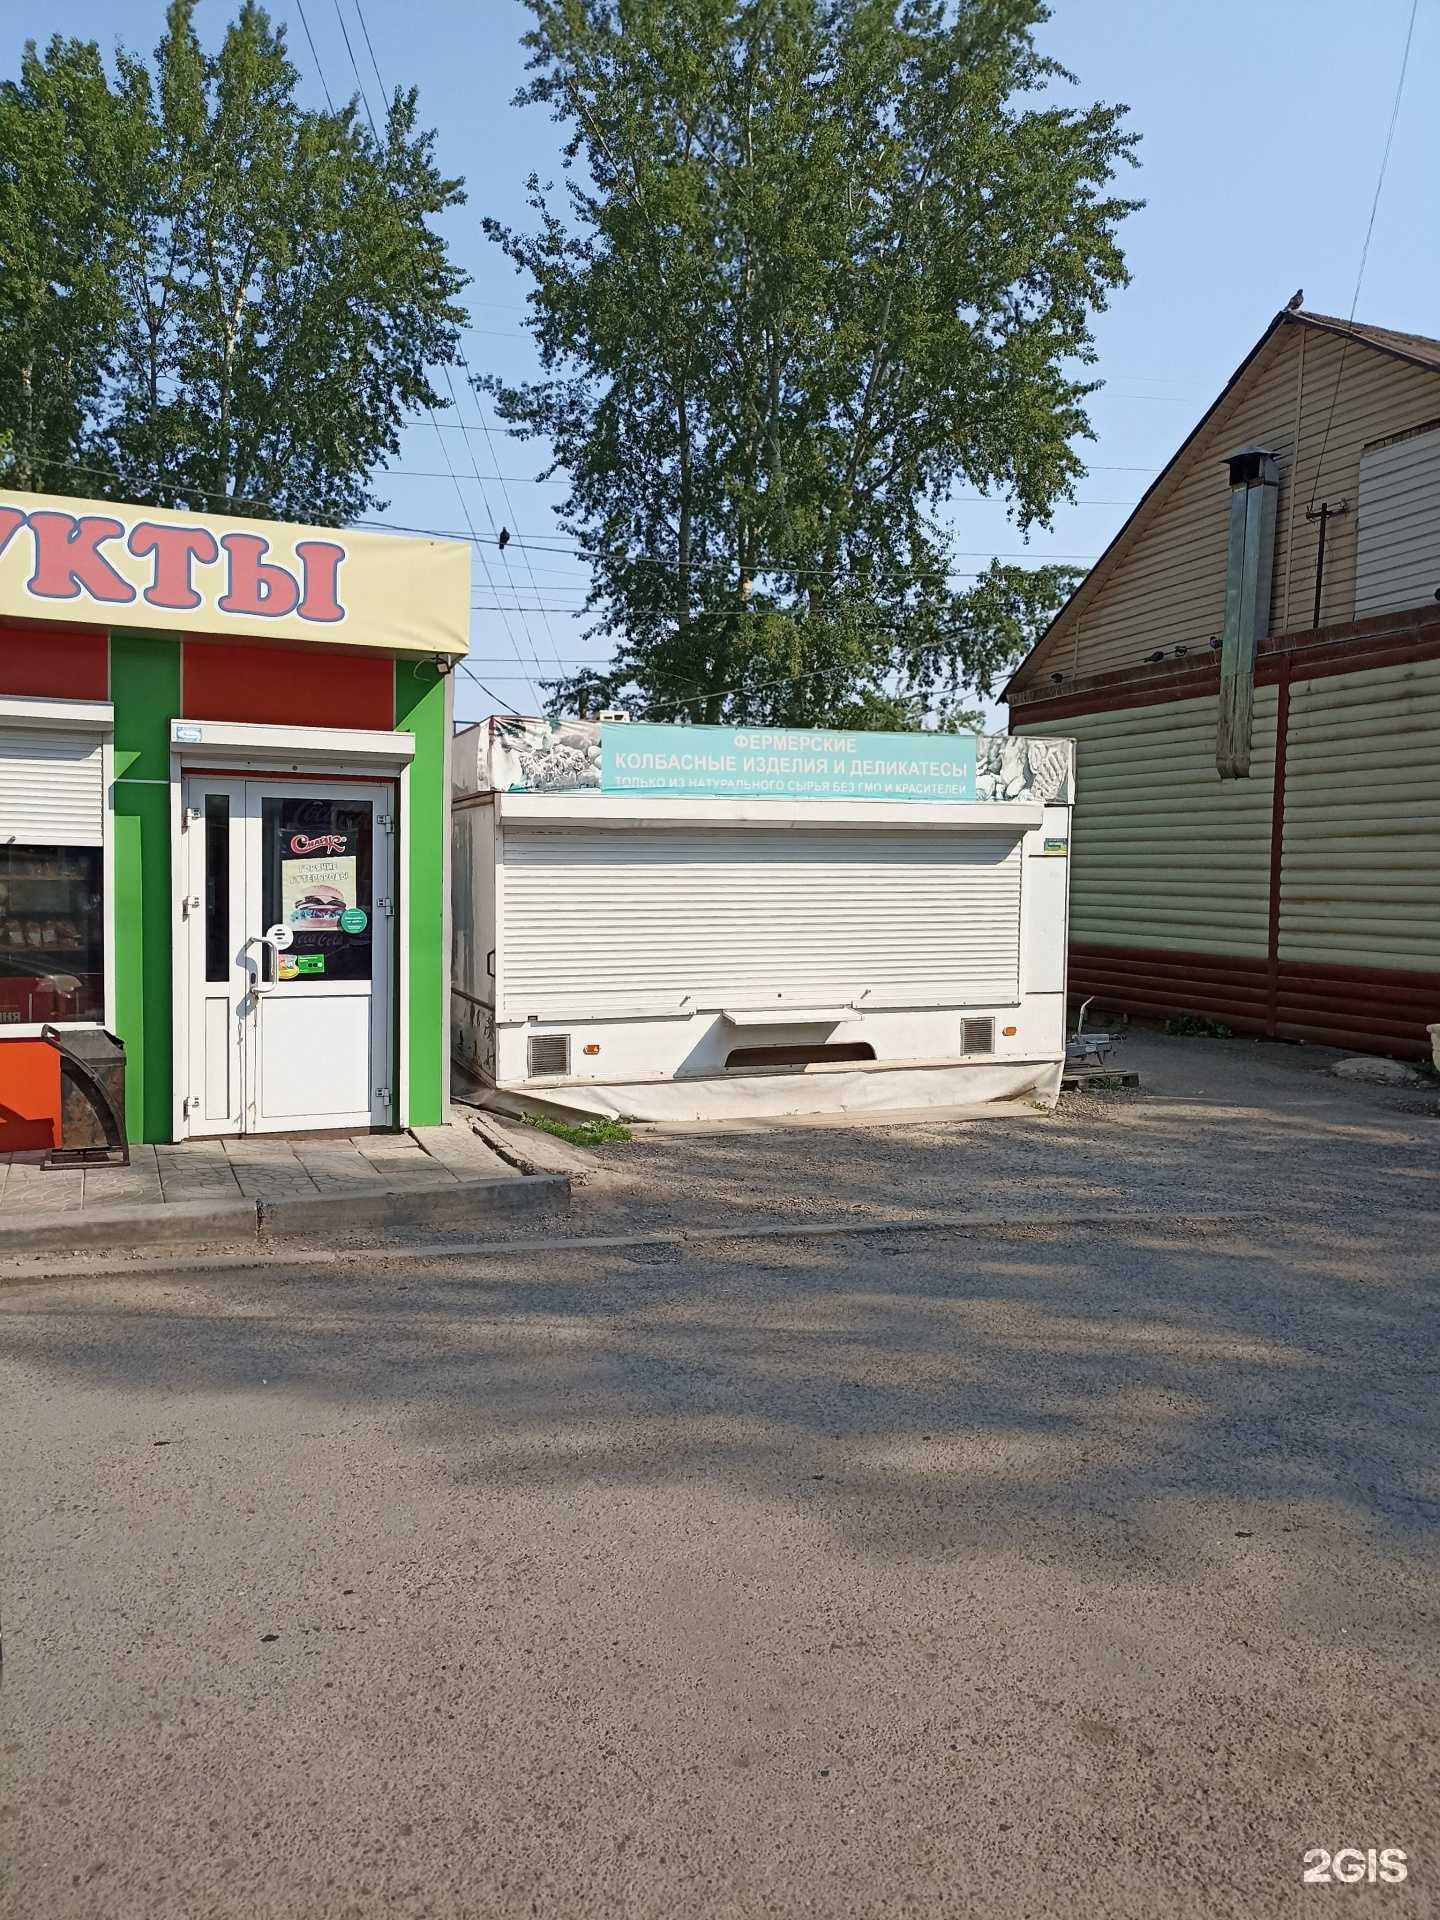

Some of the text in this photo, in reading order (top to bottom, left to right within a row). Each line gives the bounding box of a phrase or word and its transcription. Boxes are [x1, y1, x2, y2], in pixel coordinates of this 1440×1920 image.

[734, 734, 857, 753] ФЕРМЕРСКИЕ
[615, 752, 967, 778] КОЛБАСНЫЕ ИЗДЕЛИЯ И ДЕЛИКАТЕСЫ
[787, 780, 830, 792] СЫРЬЯ
[832, 782, 855, 793] БЕЗ
